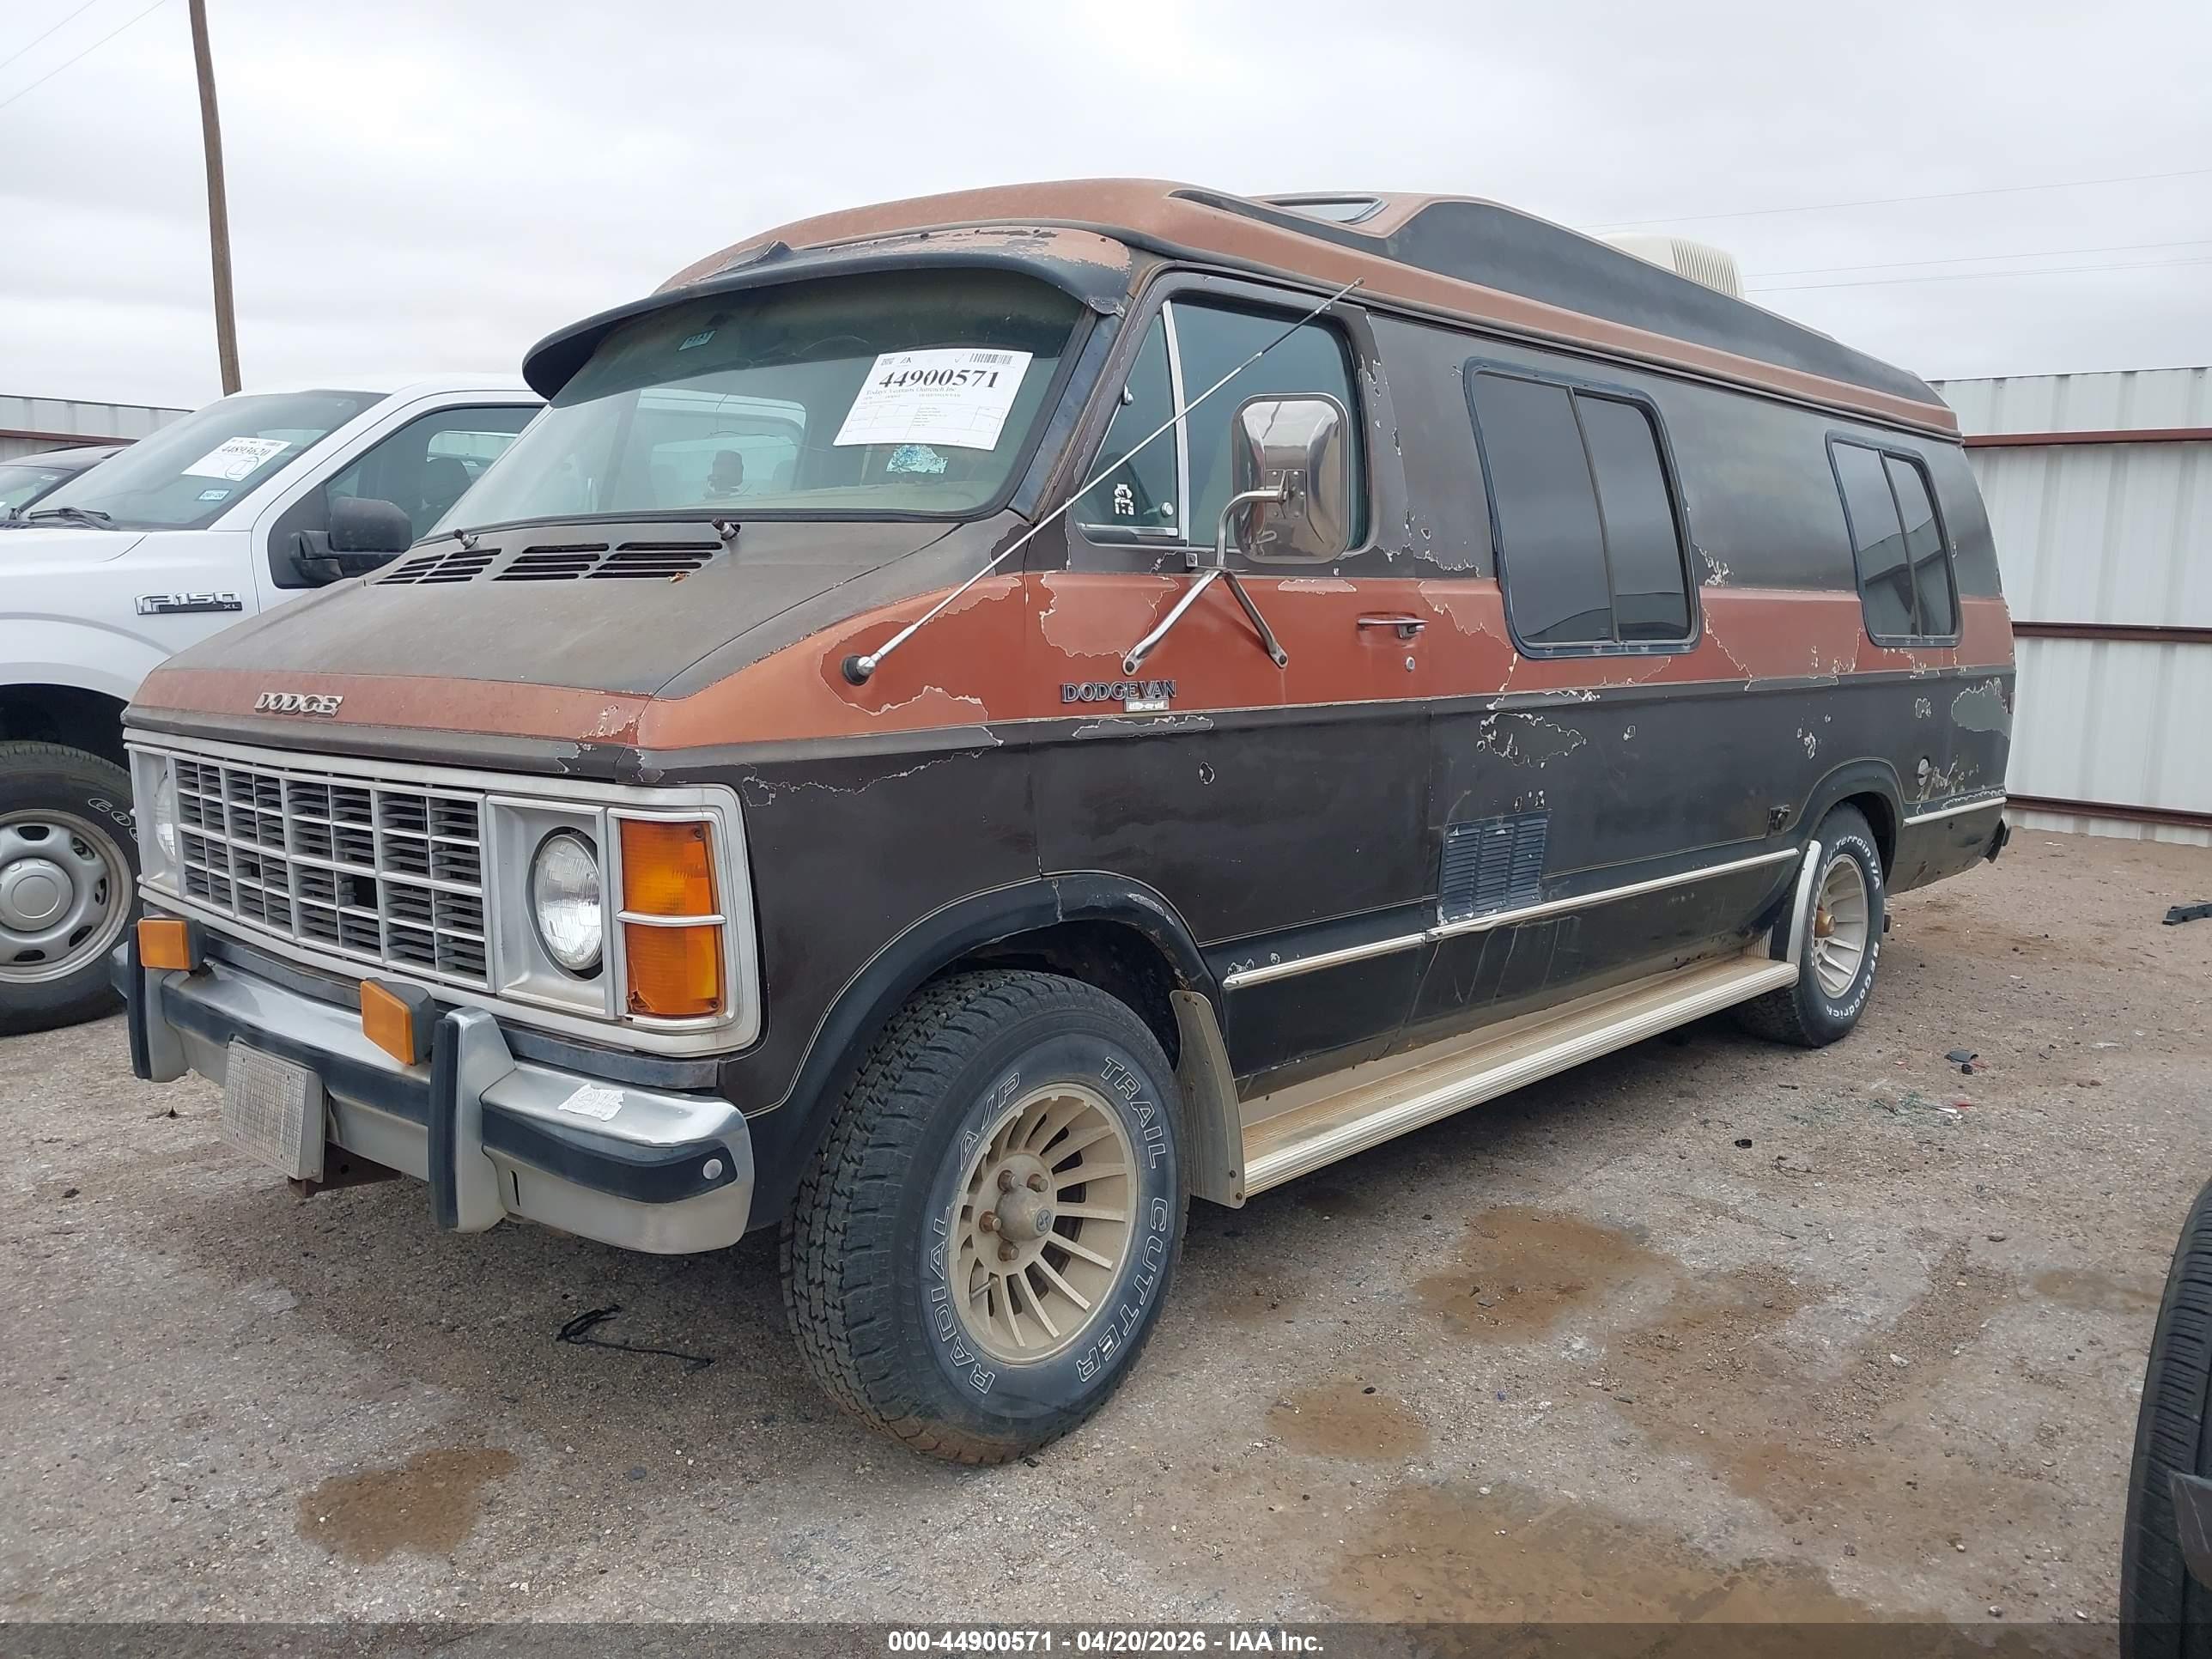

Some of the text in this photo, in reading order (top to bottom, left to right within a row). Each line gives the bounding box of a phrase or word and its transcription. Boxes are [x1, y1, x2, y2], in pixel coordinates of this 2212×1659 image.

[878, 369, 999, 389] 44900571
[254, 692, 343, 718] DODGE
[1076, 1056, 1168, 1382] TRAIL CUTTER
[929, 1206, 995, 1394] RADIAL
